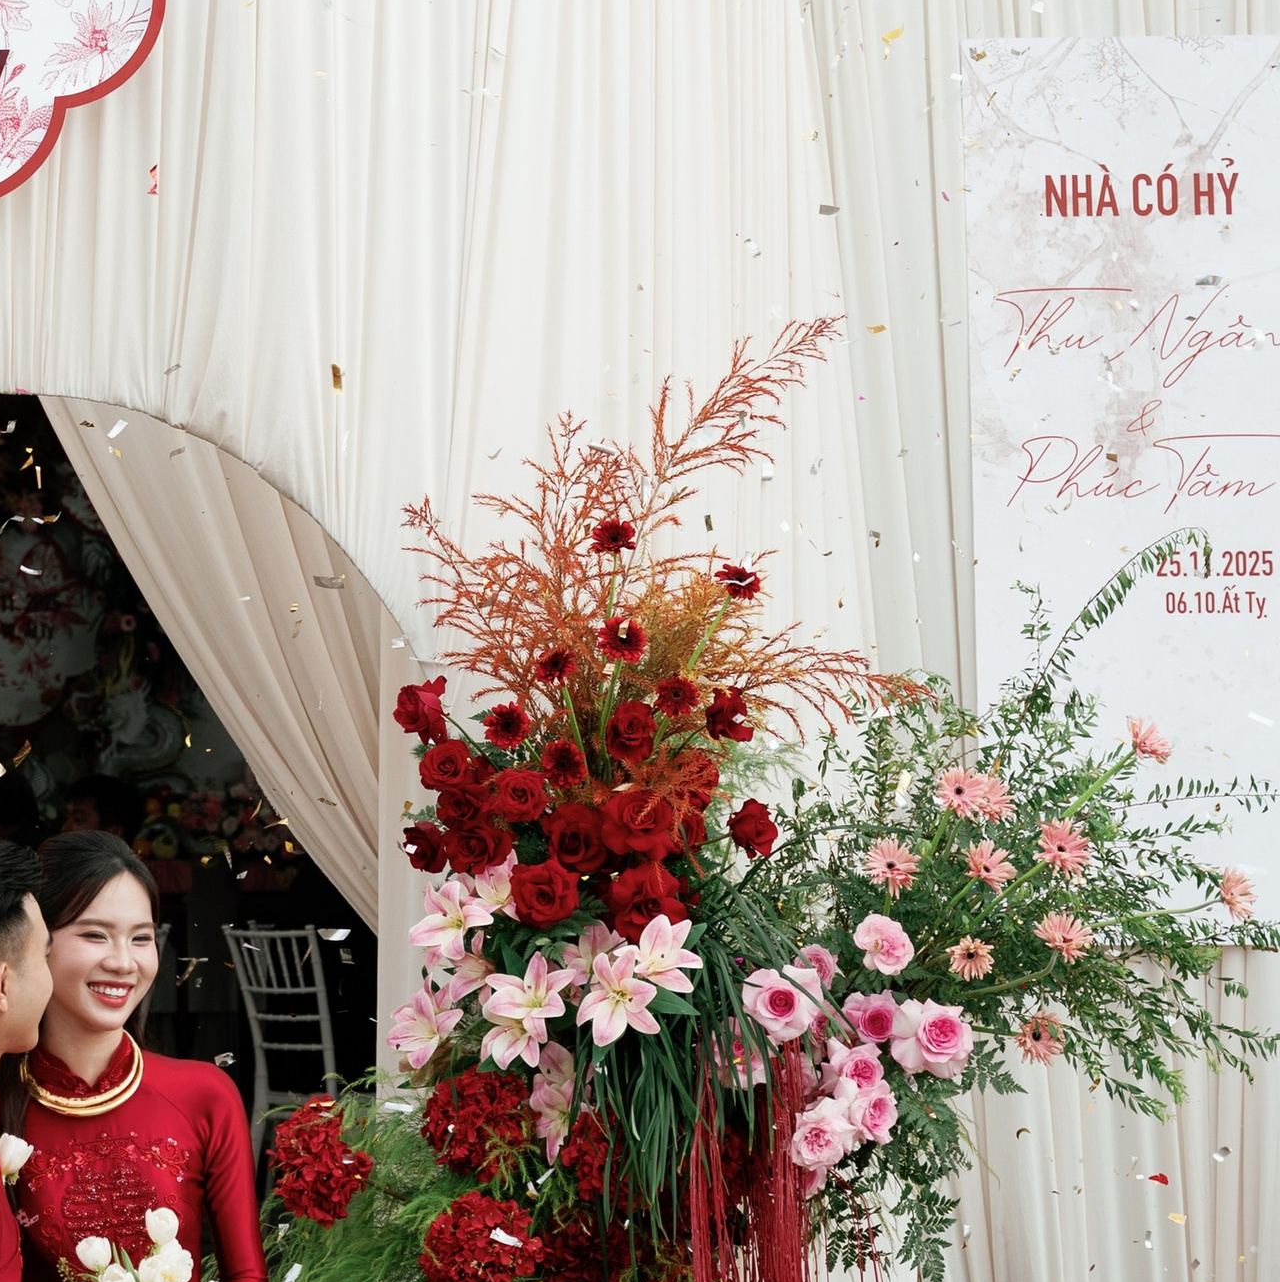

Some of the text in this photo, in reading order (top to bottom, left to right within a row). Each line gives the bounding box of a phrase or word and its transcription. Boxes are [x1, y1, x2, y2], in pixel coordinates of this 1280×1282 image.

[1044, 157, 1239, 217] NHÀ CÓ HỶ
[1126, 399, 1162, 437] &
[1006, 433, 1280, 515] Phúc Tâm
